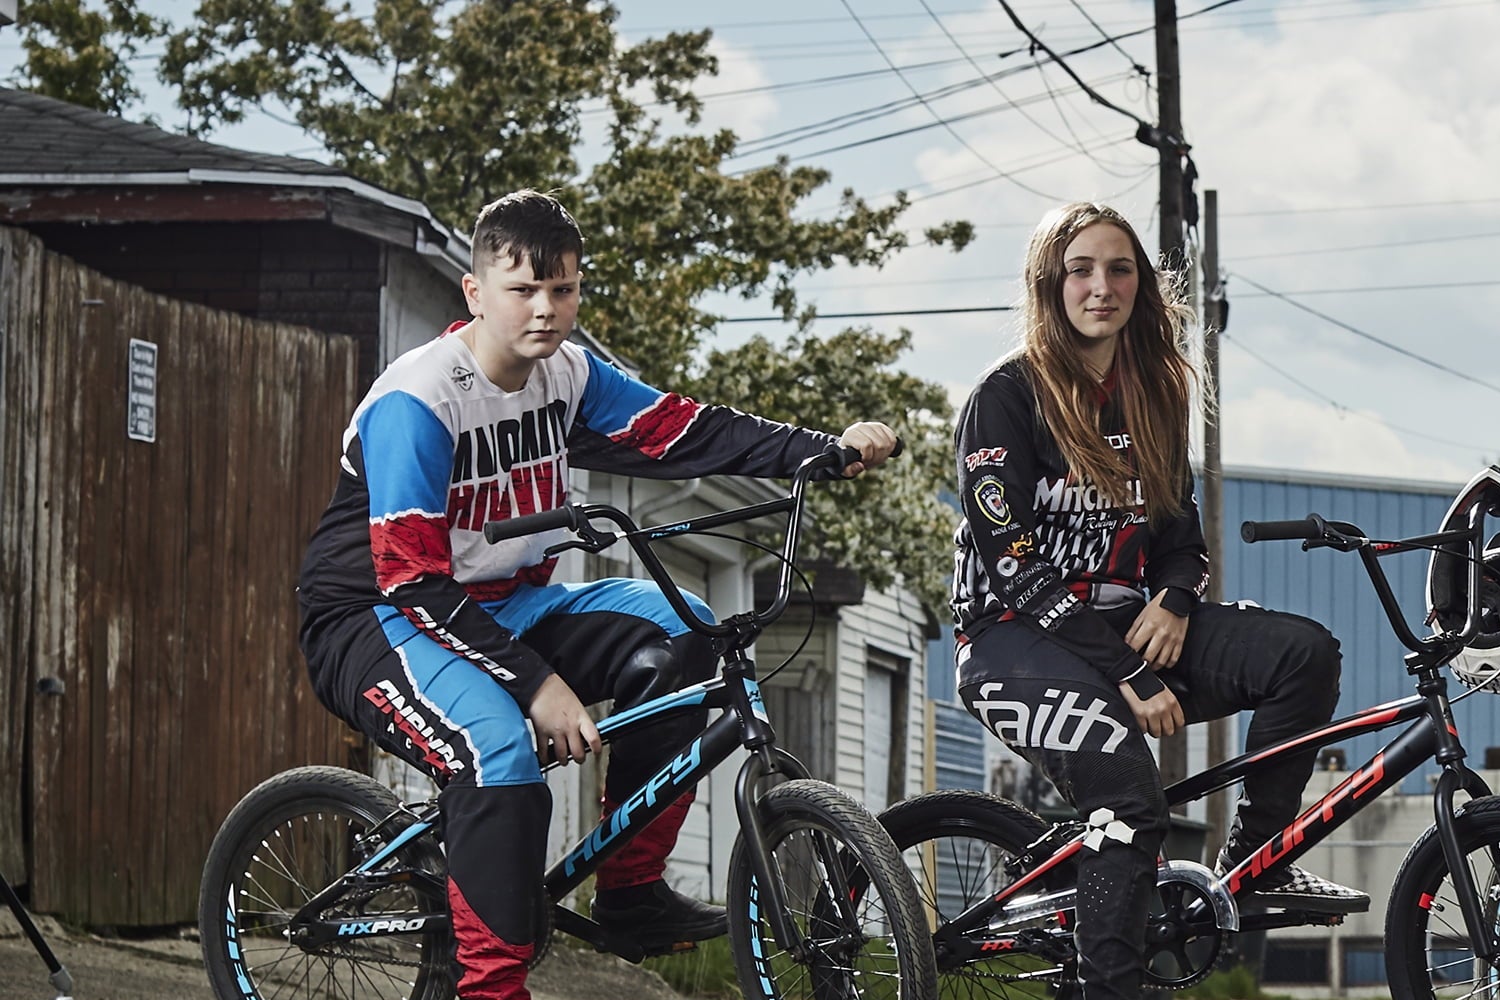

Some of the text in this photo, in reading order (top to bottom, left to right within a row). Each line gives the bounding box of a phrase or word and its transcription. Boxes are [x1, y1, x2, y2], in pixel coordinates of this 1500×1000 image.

[973, 682, 1128, 754] faith
[564, 737, 702, 877] HUFFY
[1230, 753, 1385, 894] HUFFY
[981, 939, 1015, 951] HX
